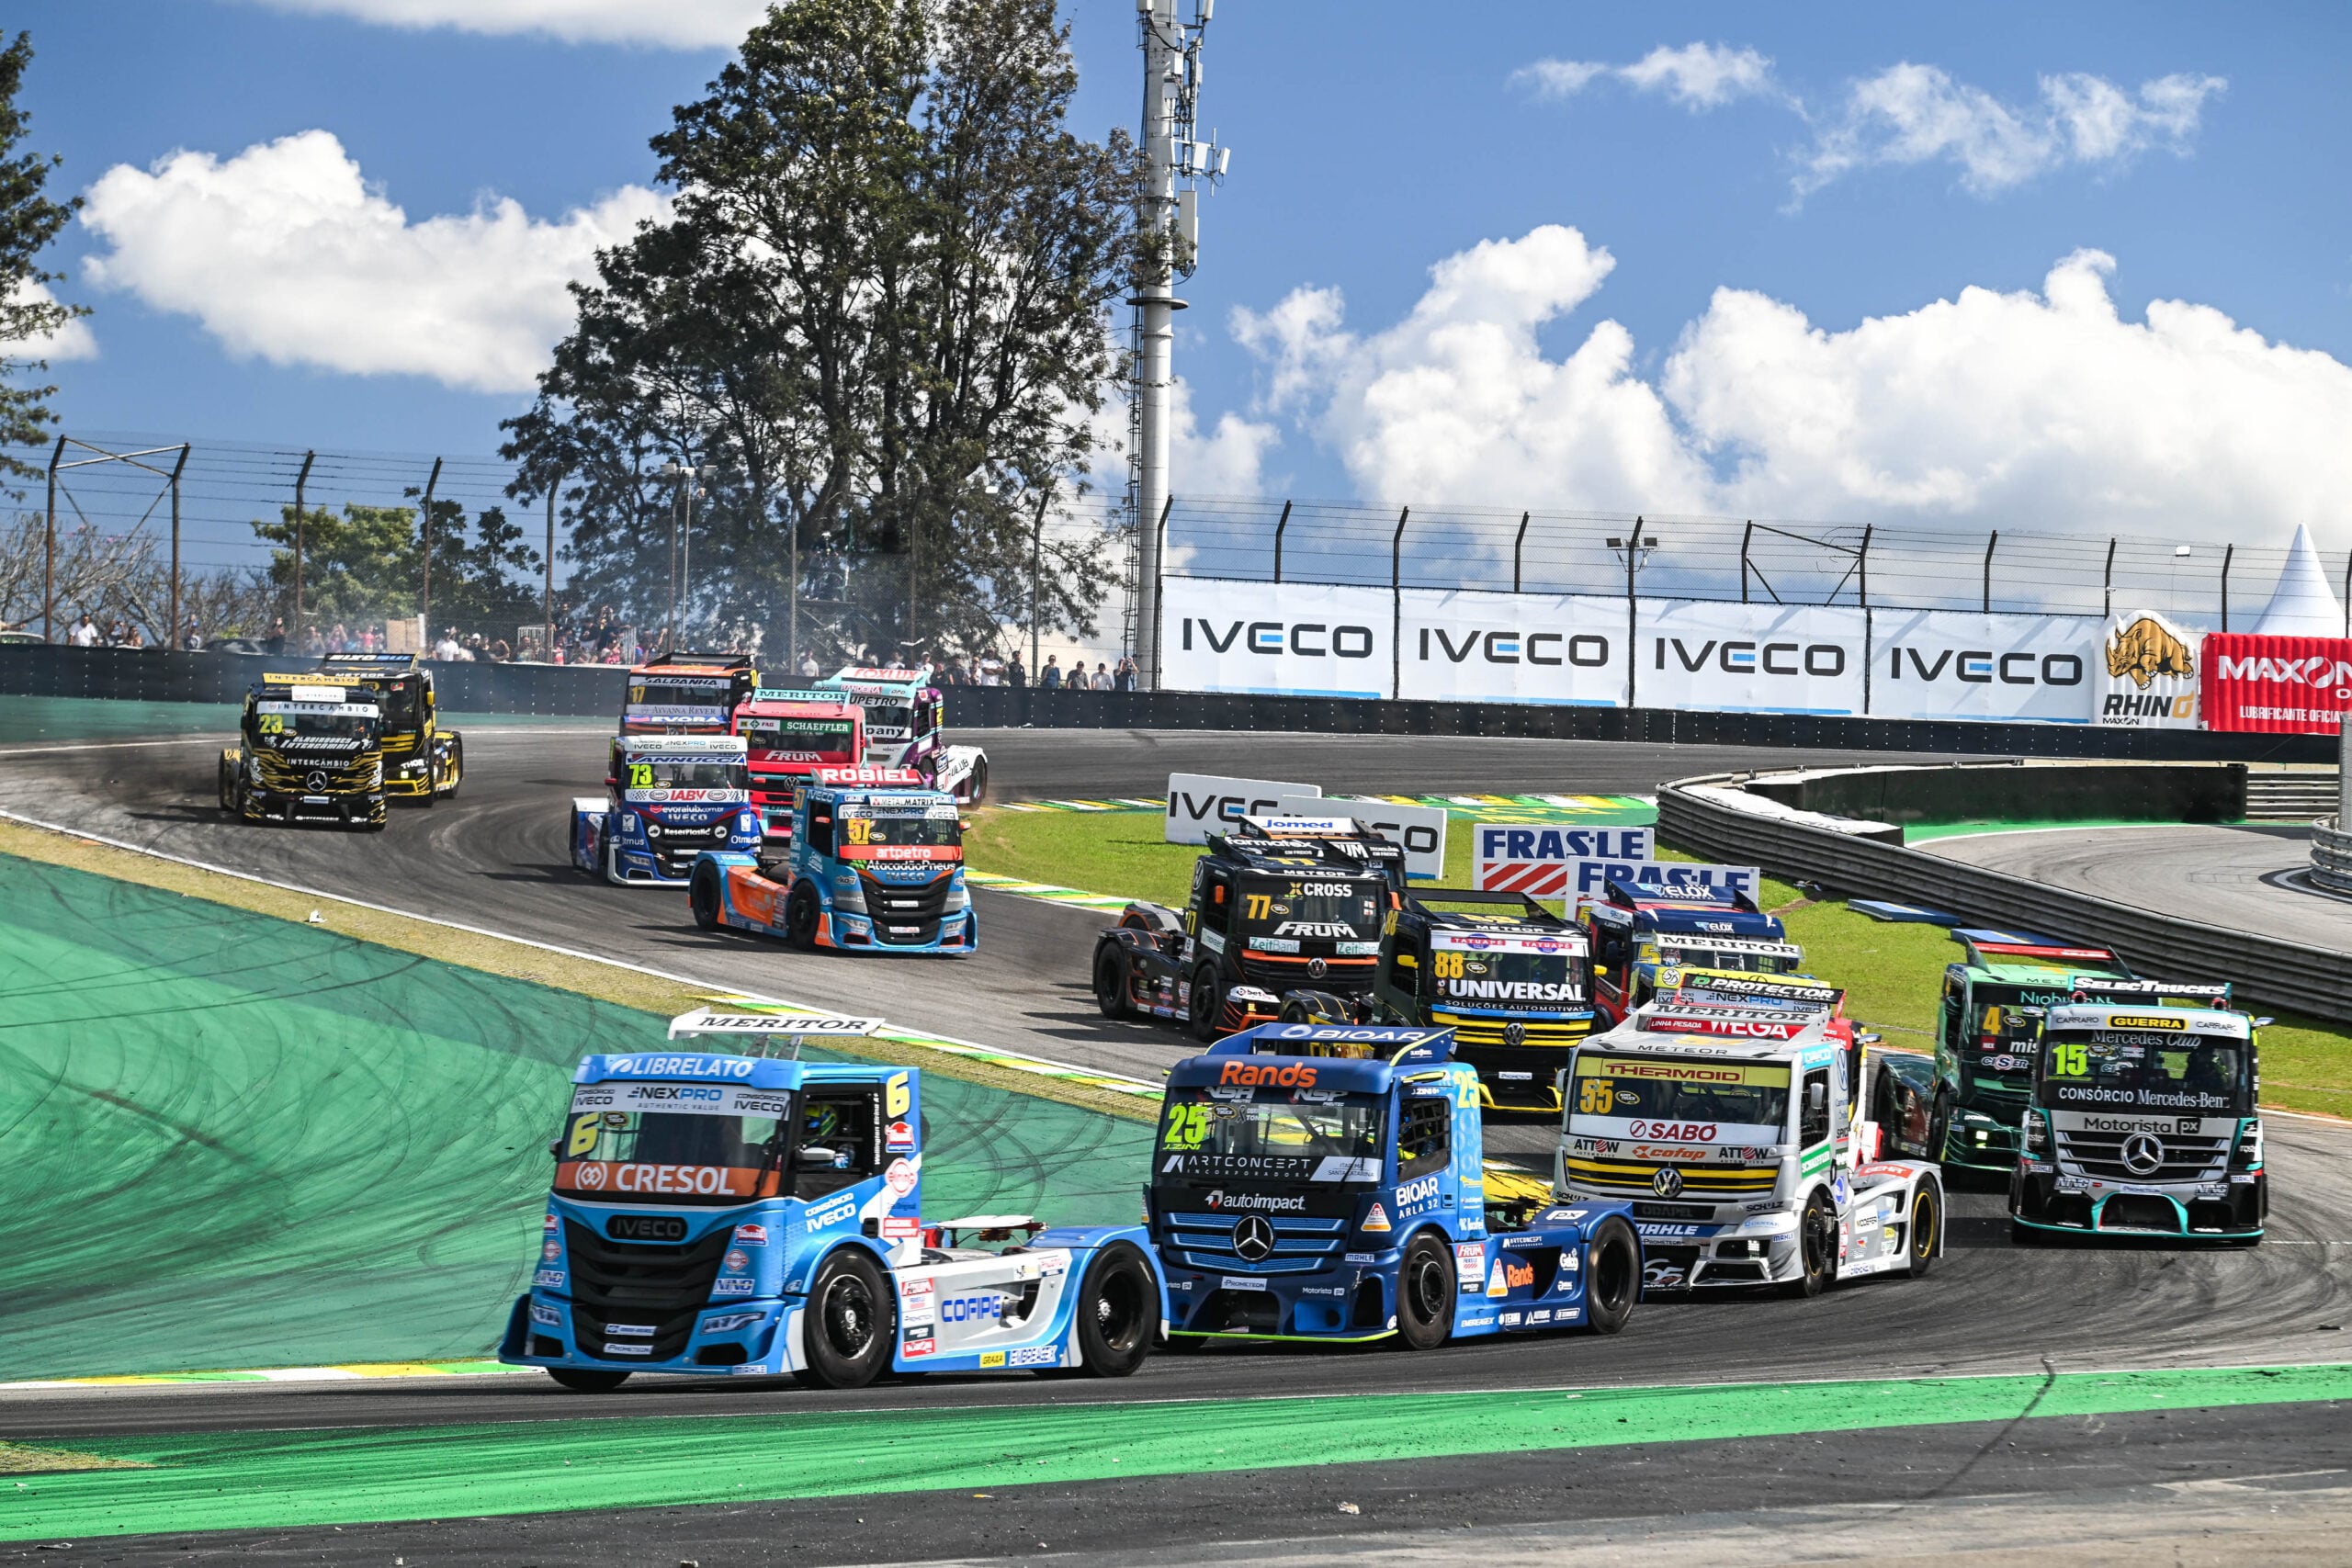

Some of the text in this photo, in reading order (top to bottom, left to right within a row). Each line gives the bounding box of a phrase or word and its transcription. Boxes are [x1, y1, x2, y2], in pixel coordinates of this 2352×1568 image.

[1182, 617, 1374, 659] IVECO
[1419, 627, 1609, 667] IVECO
[1656, 637, 1845, 676] IVECO
[1891, 647, 2083, 686] IVECO
[632, 686, 646, 704] 17
[759, 690, 846, 700] MERITOR
[2240, 705, 2341, 723] LUBRIFICANTE OFICIA
[259, 714, 283, 734] 23
[786, 721, 849, 732] SCHAEFFLER
[865, 727, 905, 739] pany
[763, 750, 823, 762] FRUM
[629, 764, 652, 785] 73
[820, 769, 920, 782] ROBIEL
[1170, 791, 1278, 822] IVEC
[847, 818, 871, 840] 57
[730, 836, 753, 844] Otmu
[876, 846, 933, 860] artpetro
[1246, 894, 1272, 920] 77
[1578, 906, 1593, 926] 5
[1273, 920, 1359, 938] FRUM
[1385, 909, 1398, 936] 88
[1475, 923, 1545, 932] METEOR
[1250, 938, 1300, 953] ZeitBank
[1639, 942, 1661, 964] 5
[1662, 935, 1800, 955] MERITOR
[1434, 952, 1464, 979] 88
[1449, 979, 1587, 1001] UNIVERSAL
[1712, 976, 1835, 999] PROTECTOR
[1509, 1004, 1586, 1013] AUTOMOTIVAS
[1714, 992, 1783, 1007] NEXPRO
[1654, 1003, 1812, 1021] MERITOR
[1982, 1006, 2002, 1035] 4
[697, 1016, 868, 1031] MERITOR
[1710, 1020, 1789, 1039] WEGA
[2055, 1016, 2100, 1024] CARRARO
[2113, 1016, 2183, 1029] GUERRA
[1310, 1029, 1426, 1041] BIOAR
[2091, 1030, 2202, 1049] Mercedes Club
[1637, 1044, 1728, 1055] METEOR
[630, 1057, 754, 1078] LIBRELATO
[2052, 1043, 2088, 1077] 15
[1605, 1062, 1741, 1082] THERMOID
[639, 1087, 723, 1101] NEXPRO
[886, 1070, 910, 1119] 6
[1453, 1070, 1481, 1110] 25
[1579, 1078, 1614, 1114] 55
[2058, 1085, 2231, 1109] CONSÓRCIO Mercedes-Benz
[574, 1096, 615, 1107] IVECO
[637, 1102, 720, 1111] AUTHENTIC VALUE
[734, 1100, 786, 1113] IVECO
[1164, 1104, 1208, 1144] 25
[1648, 1123, 1717, 1142] SABÓ
[2084, 1116, 2172, 1134] Motorista
[568, 1111, 600, 1158] 6
[1188, 1156, 1312, 1169] ARTCONCEPT
[1649, 1146, 1707, 1162] cofap
[616, 1164, 736, 1195] CRESOL
[1186, 1168, 1310, 1179] INCORPORADORA
[1396, 1177, 1440, 1207] BIOAR
[1223, 1193, 1306, 1213] autoimpact
[1398, 1198, 1439, 1220] ARLA 32
[806, 1202, 856, 1234] IVECO
[616, 1220, 683, 1238] IVECO
[1636, 1224, 1700, 1235] MAHLE
